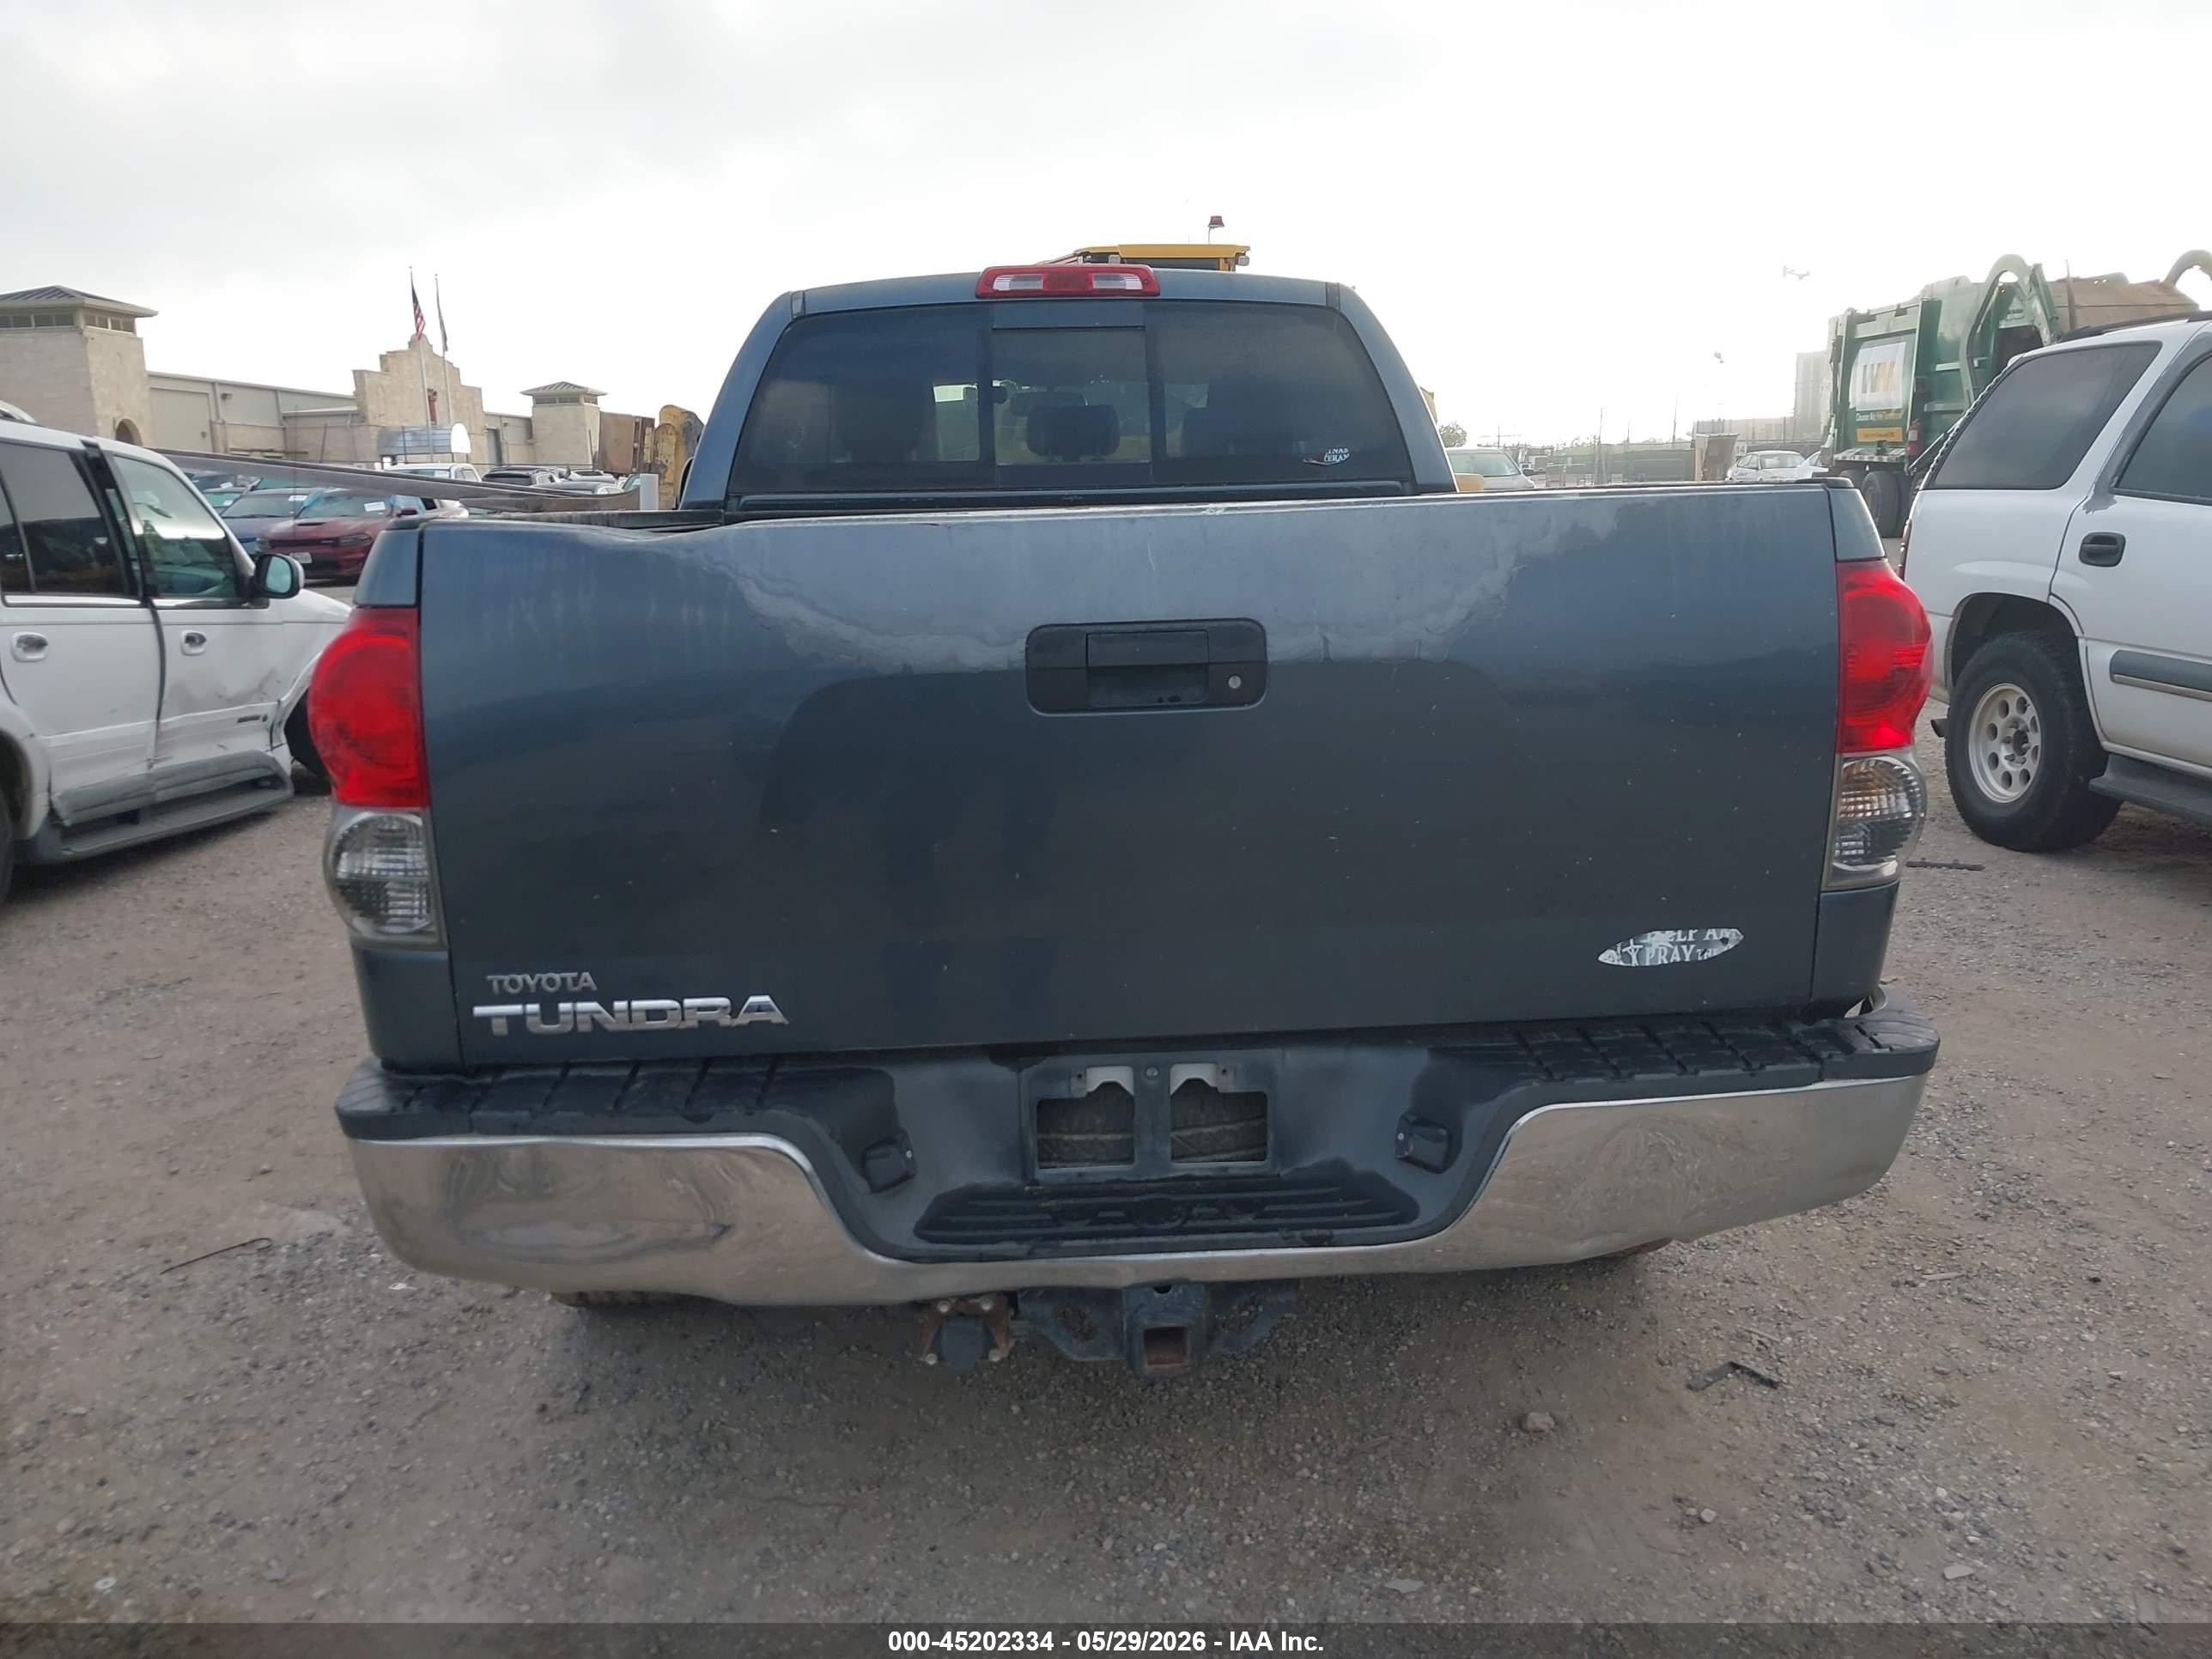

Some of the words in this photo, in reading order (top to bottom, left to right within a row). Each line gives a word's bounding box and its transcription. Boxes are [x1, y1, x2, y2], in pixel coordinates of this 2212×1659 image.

[1646, 944, 1696, 965] PRAY
[487, 972, 598, 994] TOYOTA
[472, 994, 789, 1036] TUNDRA
